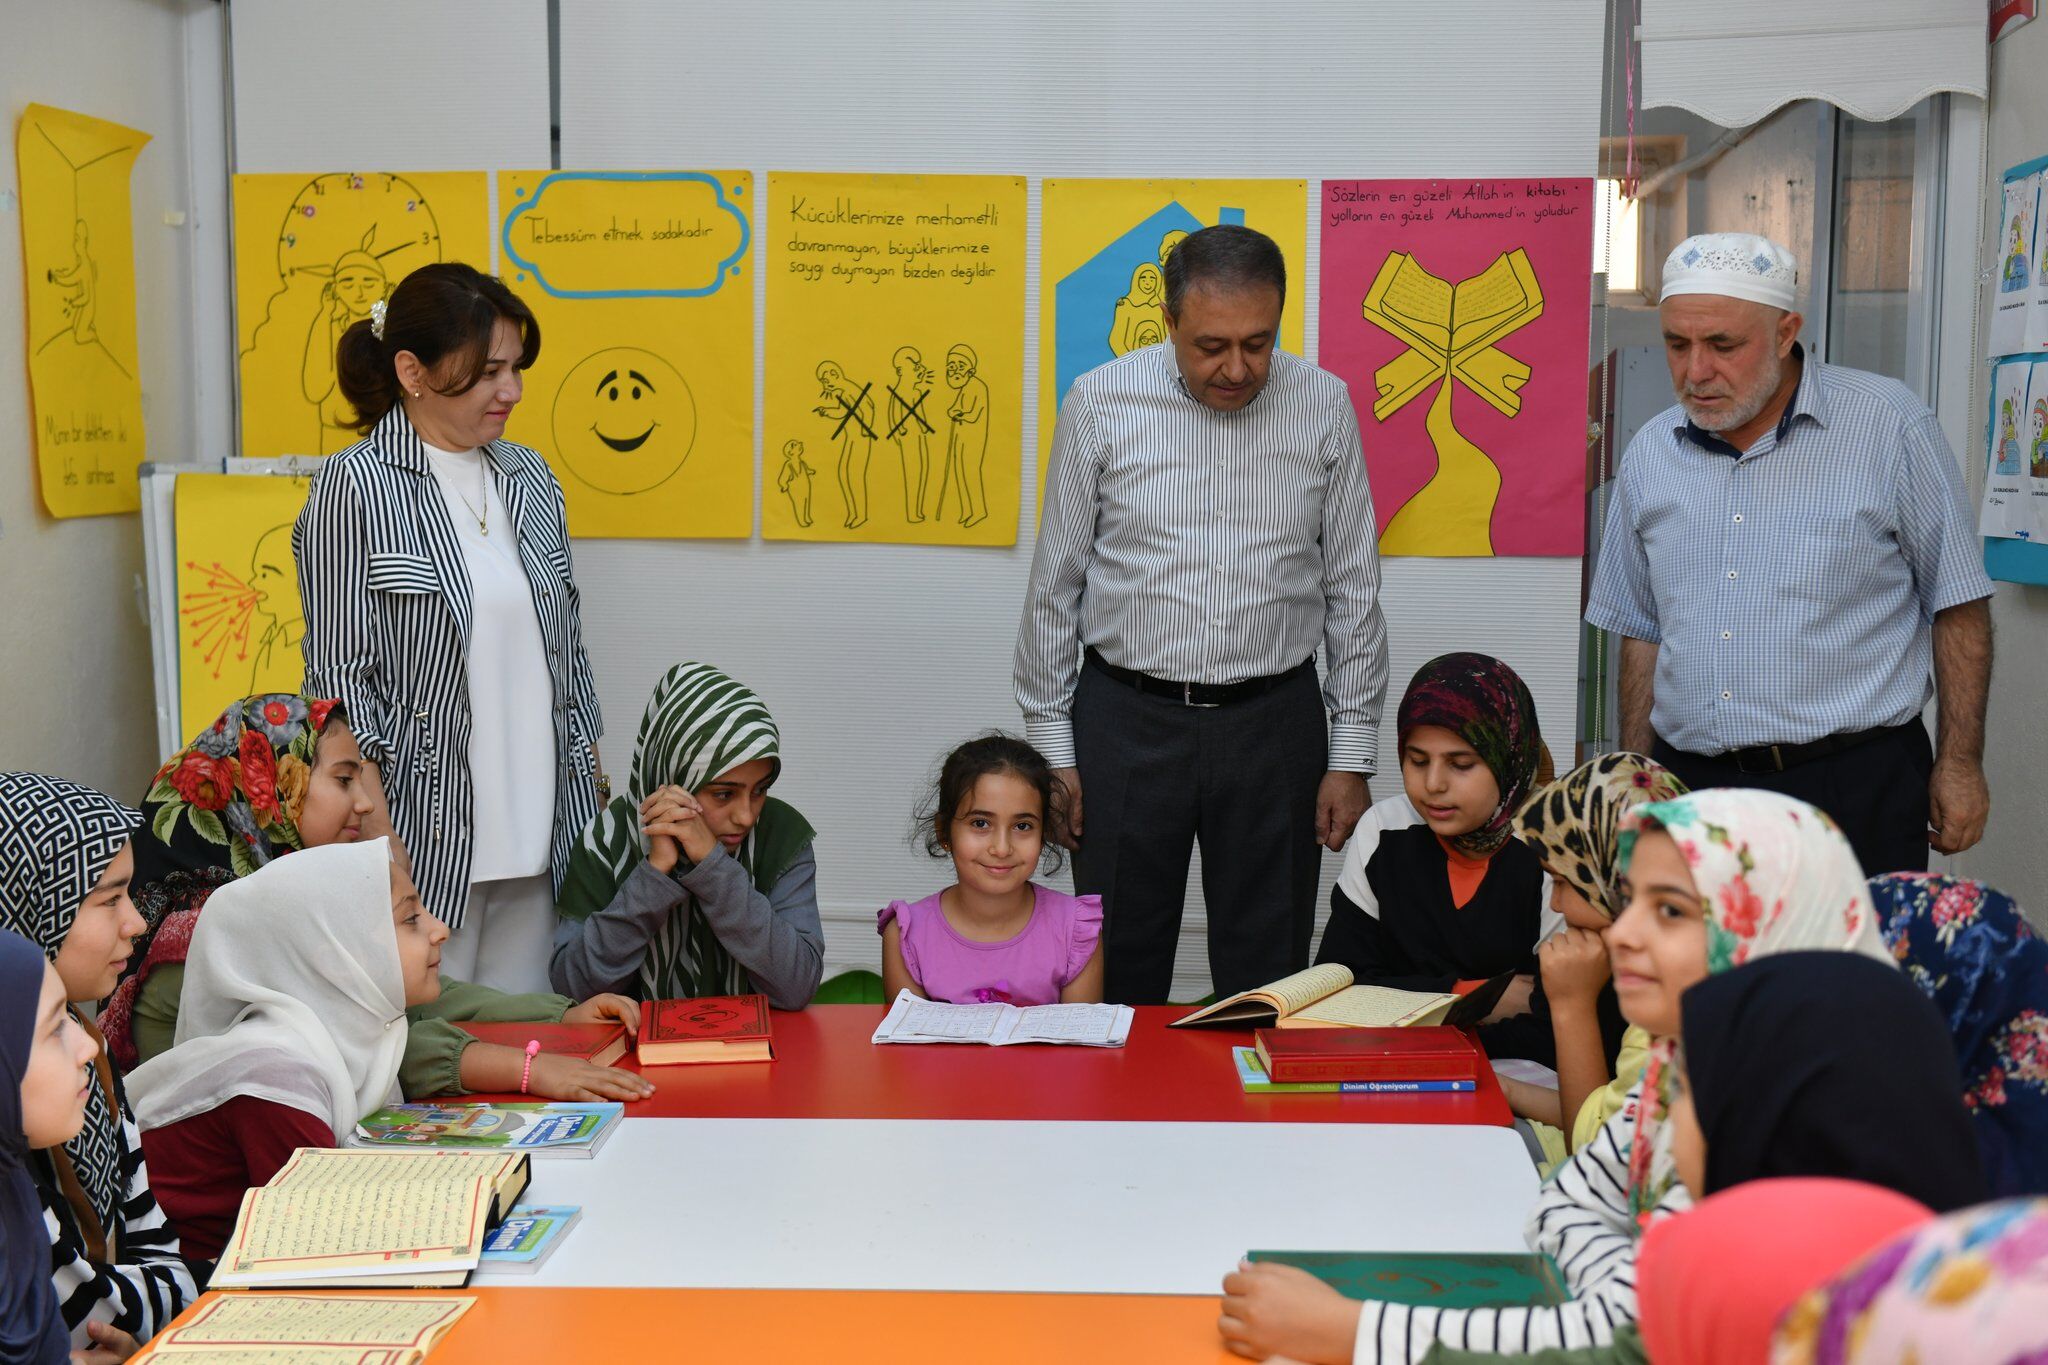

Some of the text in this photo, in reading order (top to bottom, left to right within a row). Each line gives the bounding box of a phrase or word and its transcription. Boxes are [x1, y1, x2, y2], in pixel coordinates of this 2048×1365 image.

[407, 200, 416, 211] 2
[1331, 182, 1380, 202] Sözlerin
[1389, 193, 1406, 202] en
[1412, 185, 1453, 207] güzeli
[1526, 182, 1566, 197] kitabı
[916, 203, 999, 225] merhametli
[1330, 208, 1373, 227] yolların
[1380, 212, 1395, 221] en
[1400, 208, 1435, 227] güzeli
[1534, 203, 1580, 224] yoludur
[287, 234, 296, 248] 9
[422, 232, 430, 245] 3
[524, 216, 597, 244] Tebessüm
[603, 215, 643, 241] etmek
[787, 232, 990, 263] davranmayan, büyüklerimize
[789, 261, 996, 285] saygı duymayan bizden değildir
[1343, 1082, 1367, 1090] Dinimi
[1369, 1080, 1419, 1092] Öğreniyorum
